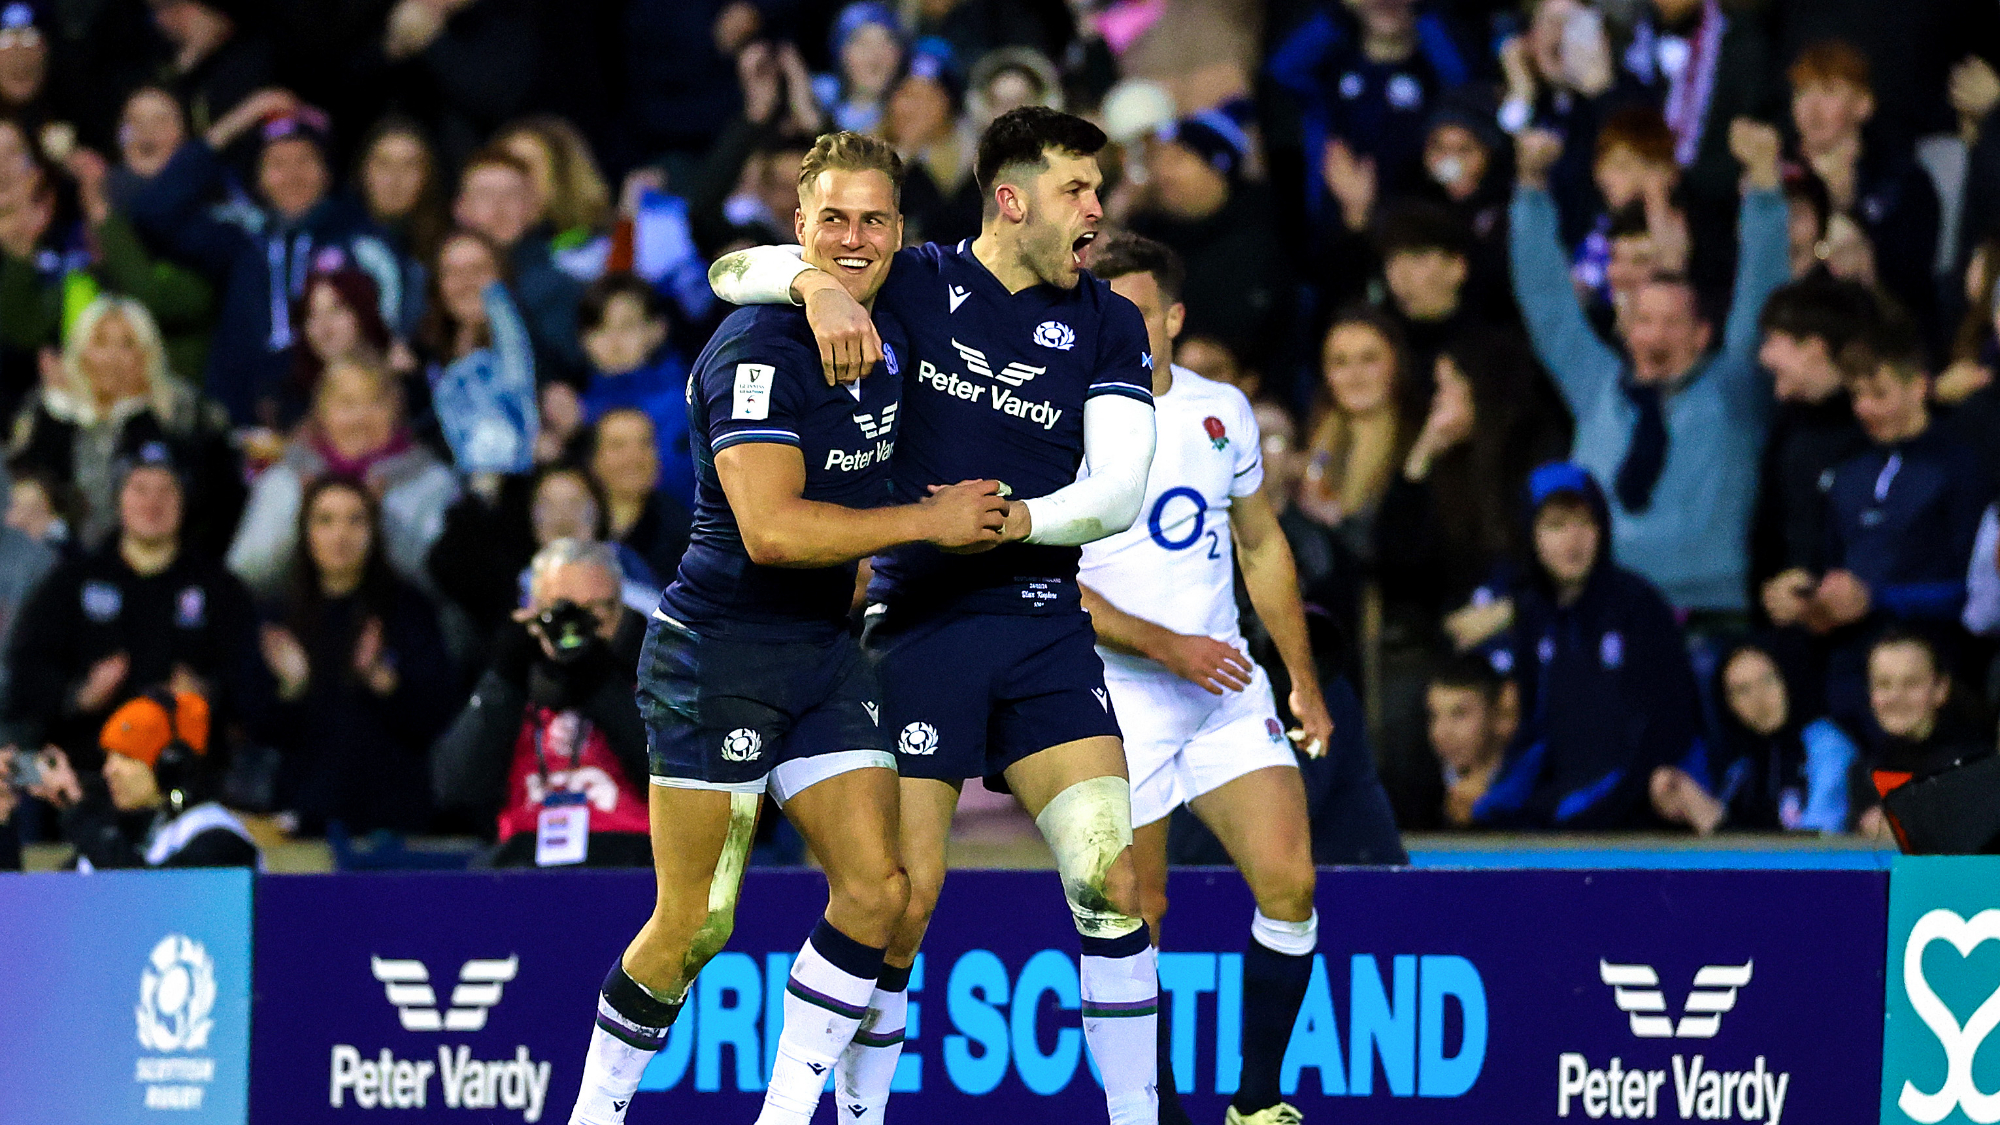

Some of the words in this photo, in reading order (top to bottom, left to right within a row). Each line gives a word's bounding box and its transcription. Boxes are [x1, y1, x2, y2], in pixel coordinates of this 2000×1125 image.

[918, 359, 986, 403] Peter
[991, 384, 1063, 430] Vardy
[824, 449, 875, 472] Peter
[876, 439, 895, 463] Var
[943, 948, 1489, 1097] SCTLAND
[329, 1044, 435, 1109] Peter
[438, 1044, 552, 1123] Vardy
[1557, 1052, 1667, 1119] Peter
[1671, 1053, 1790, 1125] Vardy
